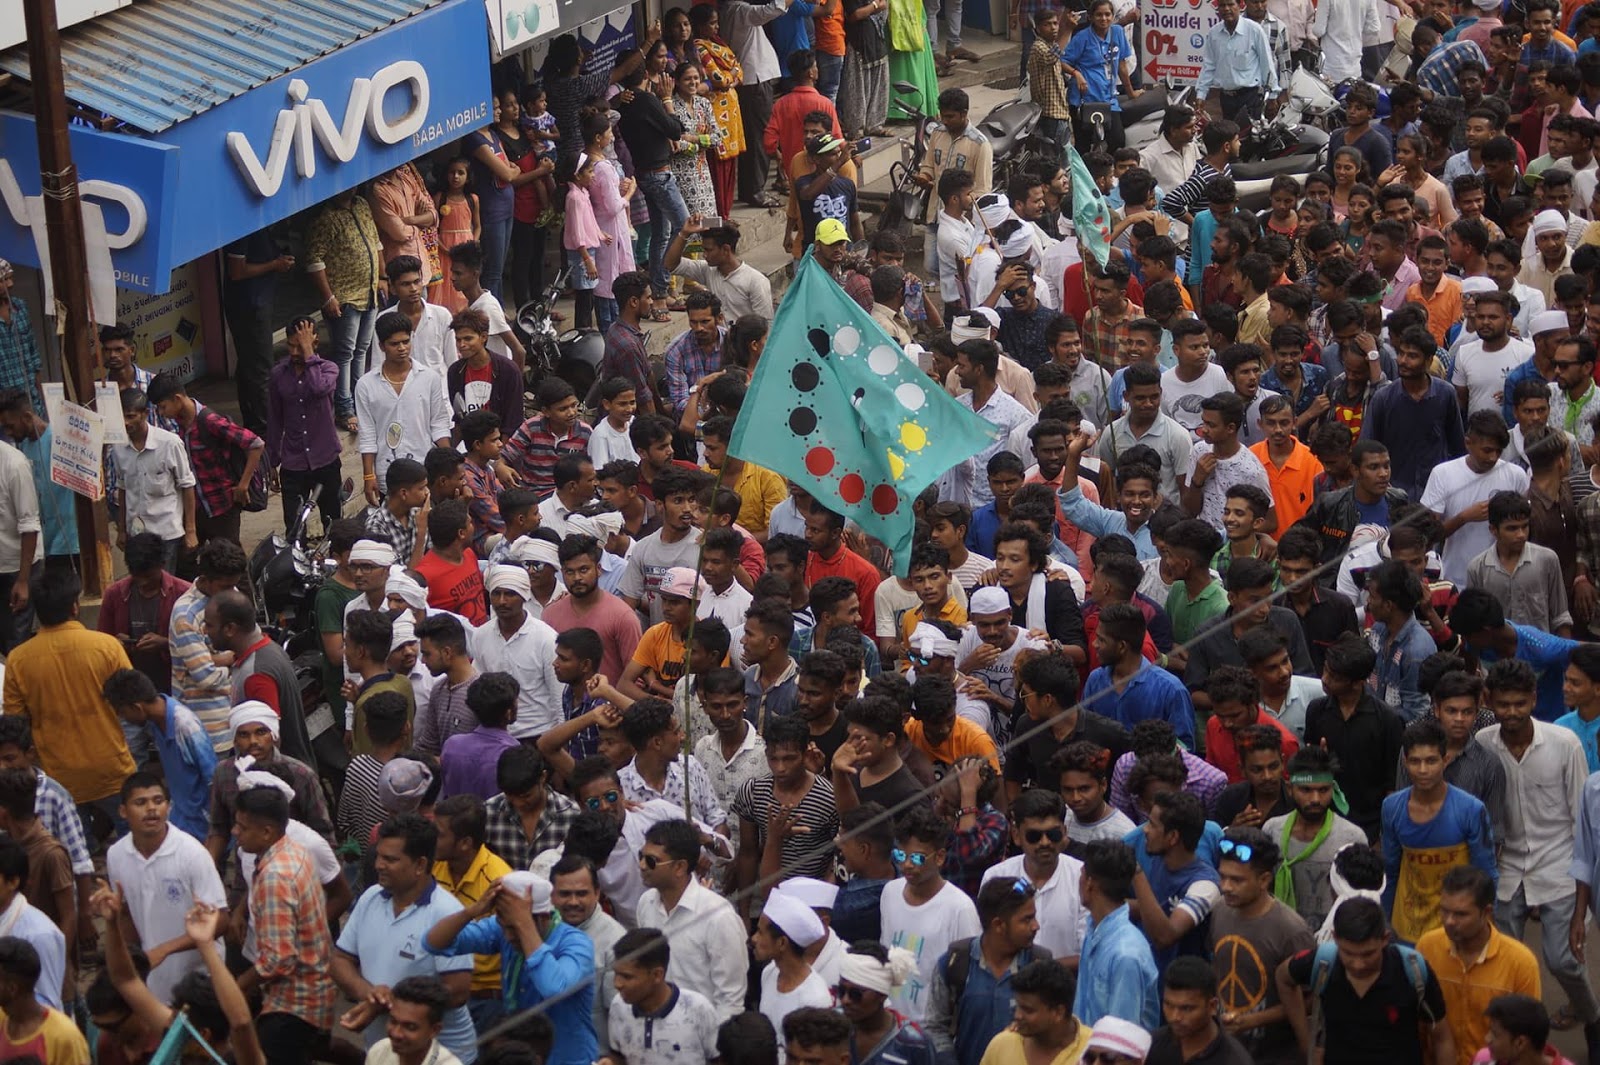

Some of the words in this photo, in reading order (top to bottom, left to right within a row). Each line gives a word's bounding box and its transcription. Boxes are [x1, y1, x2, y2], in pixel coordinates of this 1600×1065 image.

[1145, 9, 1200, 29] મોબાઈલ
[1146, 29, 1178, 56] 0%
[227, 60, 430, 197] vivo
[413, 122, 444, 147] BABA
[446, 102, 487, 132] MOBILE
[113, 269, 149, 288] OBILE
[450, 571, 481, 602] SUMME
